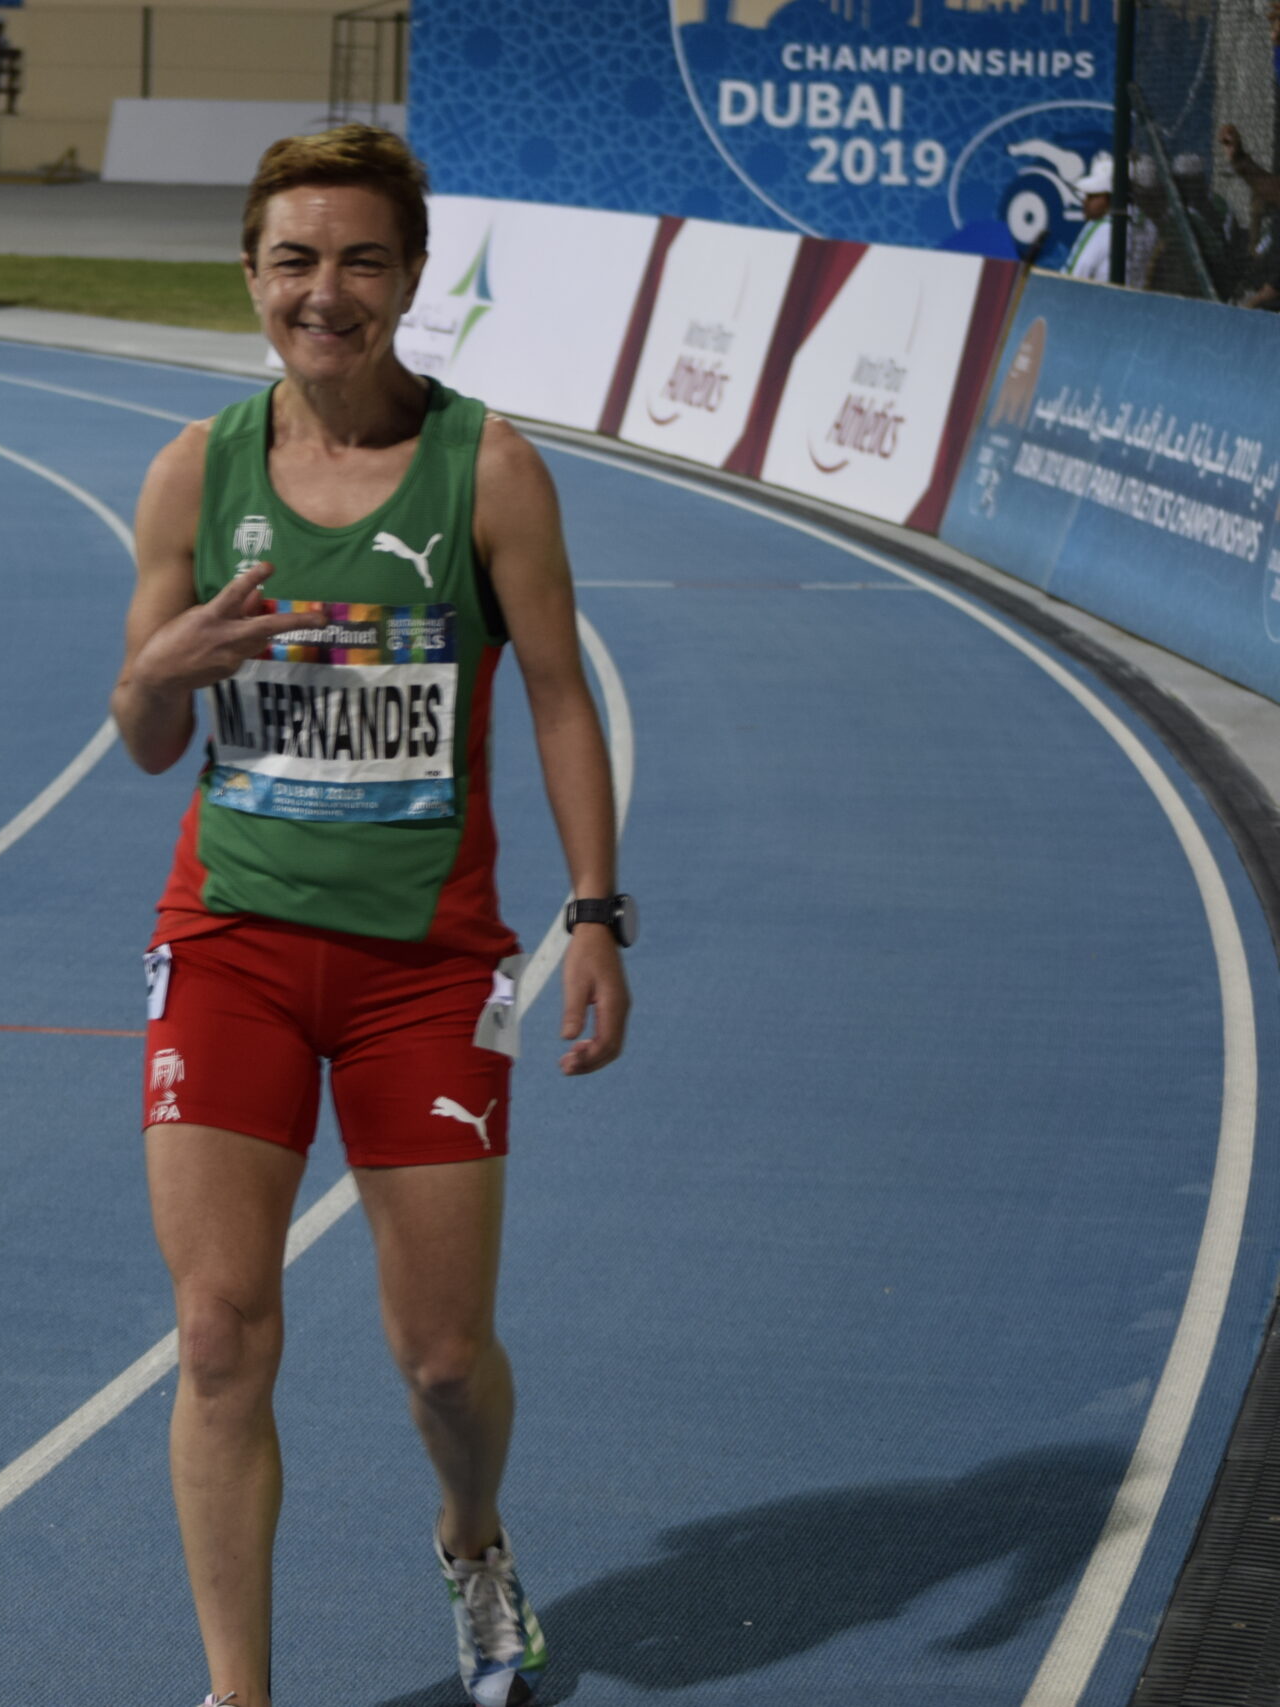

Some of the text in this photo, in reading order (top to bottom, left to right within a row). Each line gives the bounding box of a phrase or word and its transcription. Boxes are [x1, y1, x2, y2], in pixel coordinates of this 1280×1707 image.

[781, 42, 1095, 79] CHAMPIONSHIPS
[719, 79, 903, 131] DUBAI
[806, 138, 947, 187] 2019
[1116, 475, 1175, 530] ATHLETICS
[1166, 493, 1264, 564] CHAMPIONSHIPS
[213, 679, 443, 761] M. FERNANDES
[272, 782, 323, 799] DUBAI
